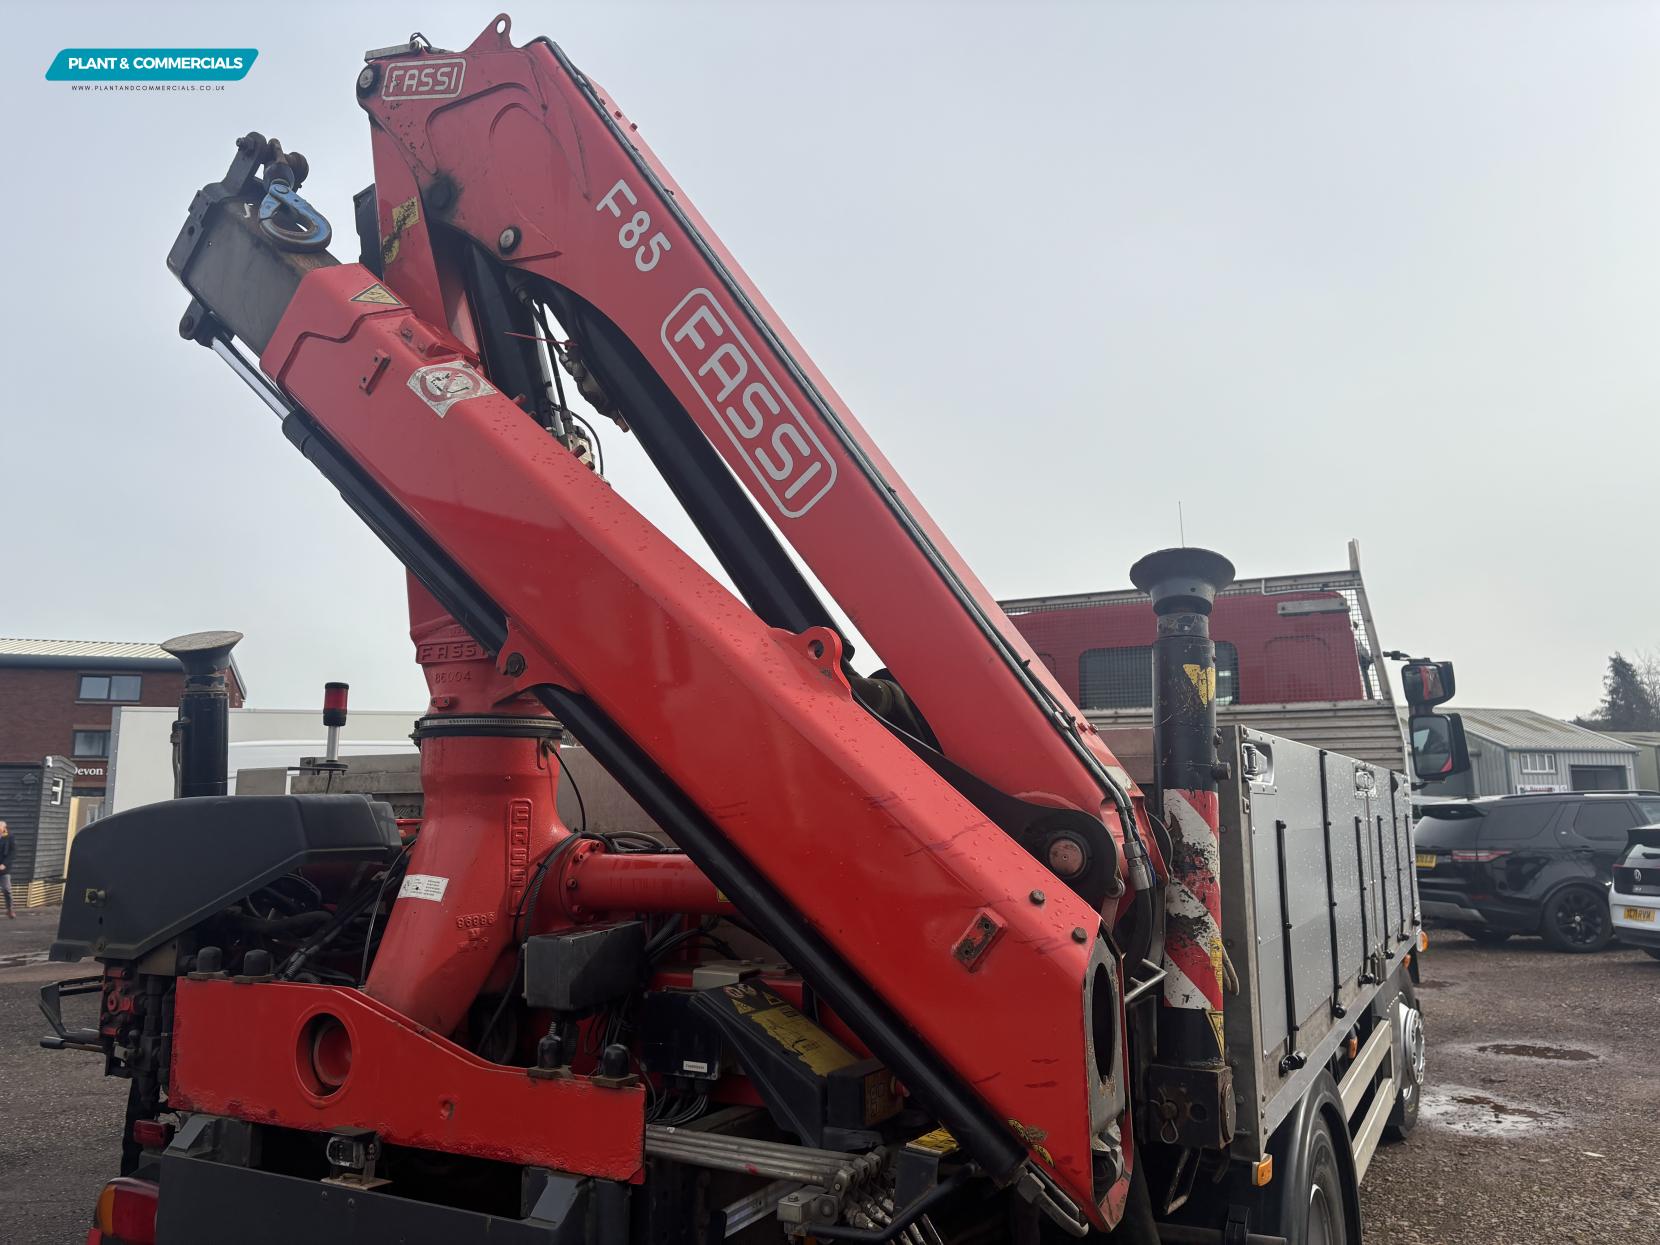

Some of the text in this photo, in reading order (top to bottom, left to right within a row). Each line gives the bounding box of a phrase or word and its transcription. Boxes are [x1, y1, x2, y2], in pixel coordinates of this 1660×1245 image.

[388, 66, 458, 93] FASSI
[596, 179, 672, 272] F85
[674, 305, 821, 499] FASSI
